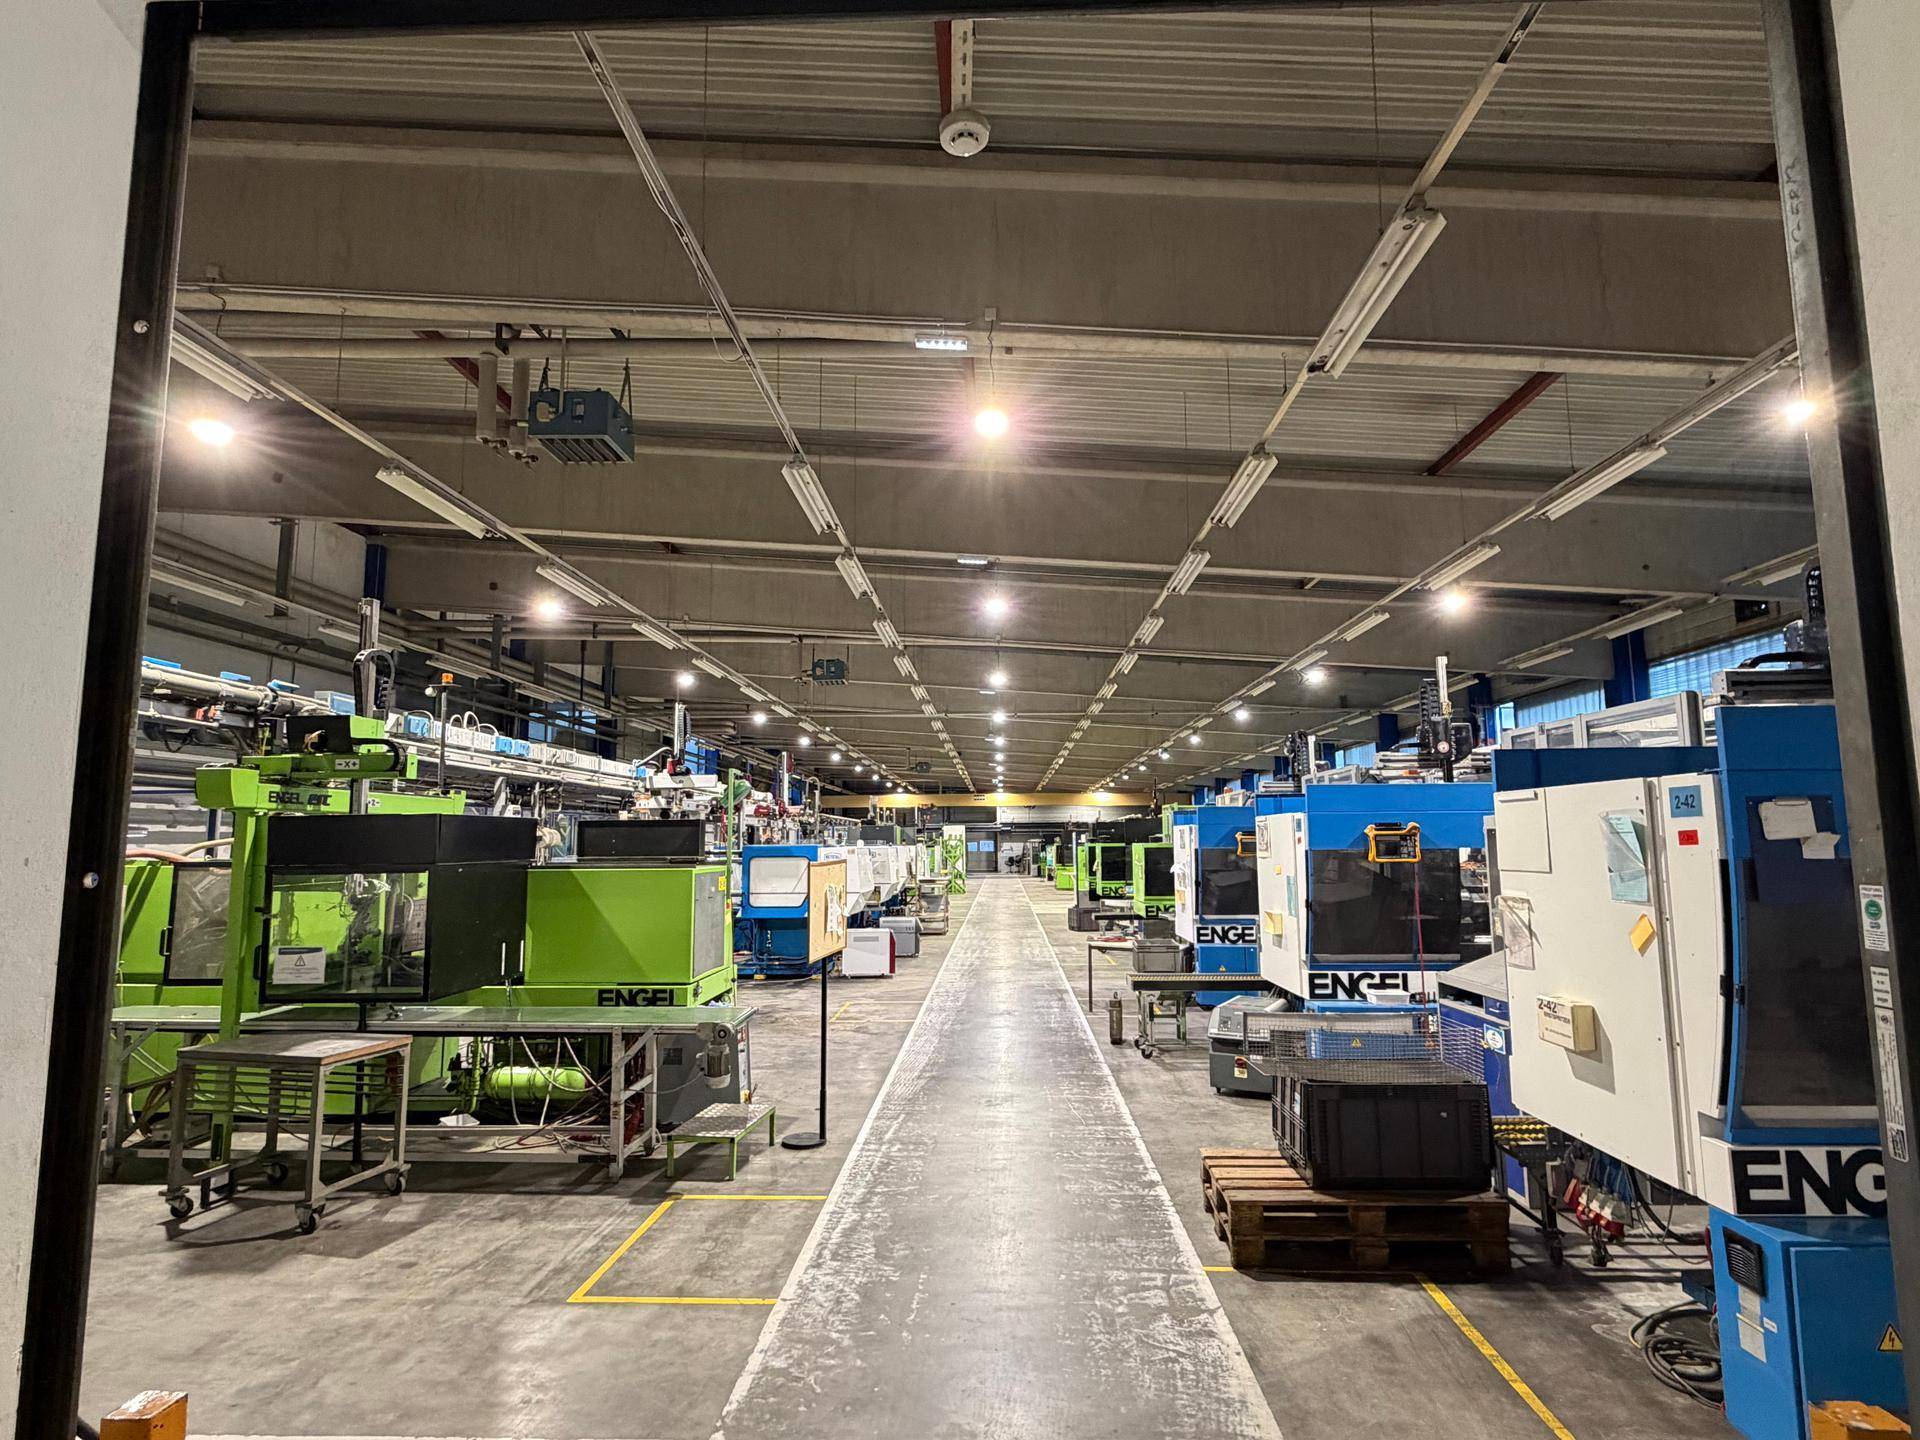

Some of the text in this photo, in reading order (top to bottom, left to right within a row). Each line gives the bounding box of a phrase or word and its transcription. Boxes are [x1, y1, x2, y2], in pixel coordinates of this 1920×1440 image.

[269, 790, 304, 804] ENGEL
[1674, 794, 1696, 809] 2-42
[1196, 926, 1257, 944] ENGE
[1536, 997, 1558, 1014] 2-42
[1731, 1148, 1888, 1217] ENG
